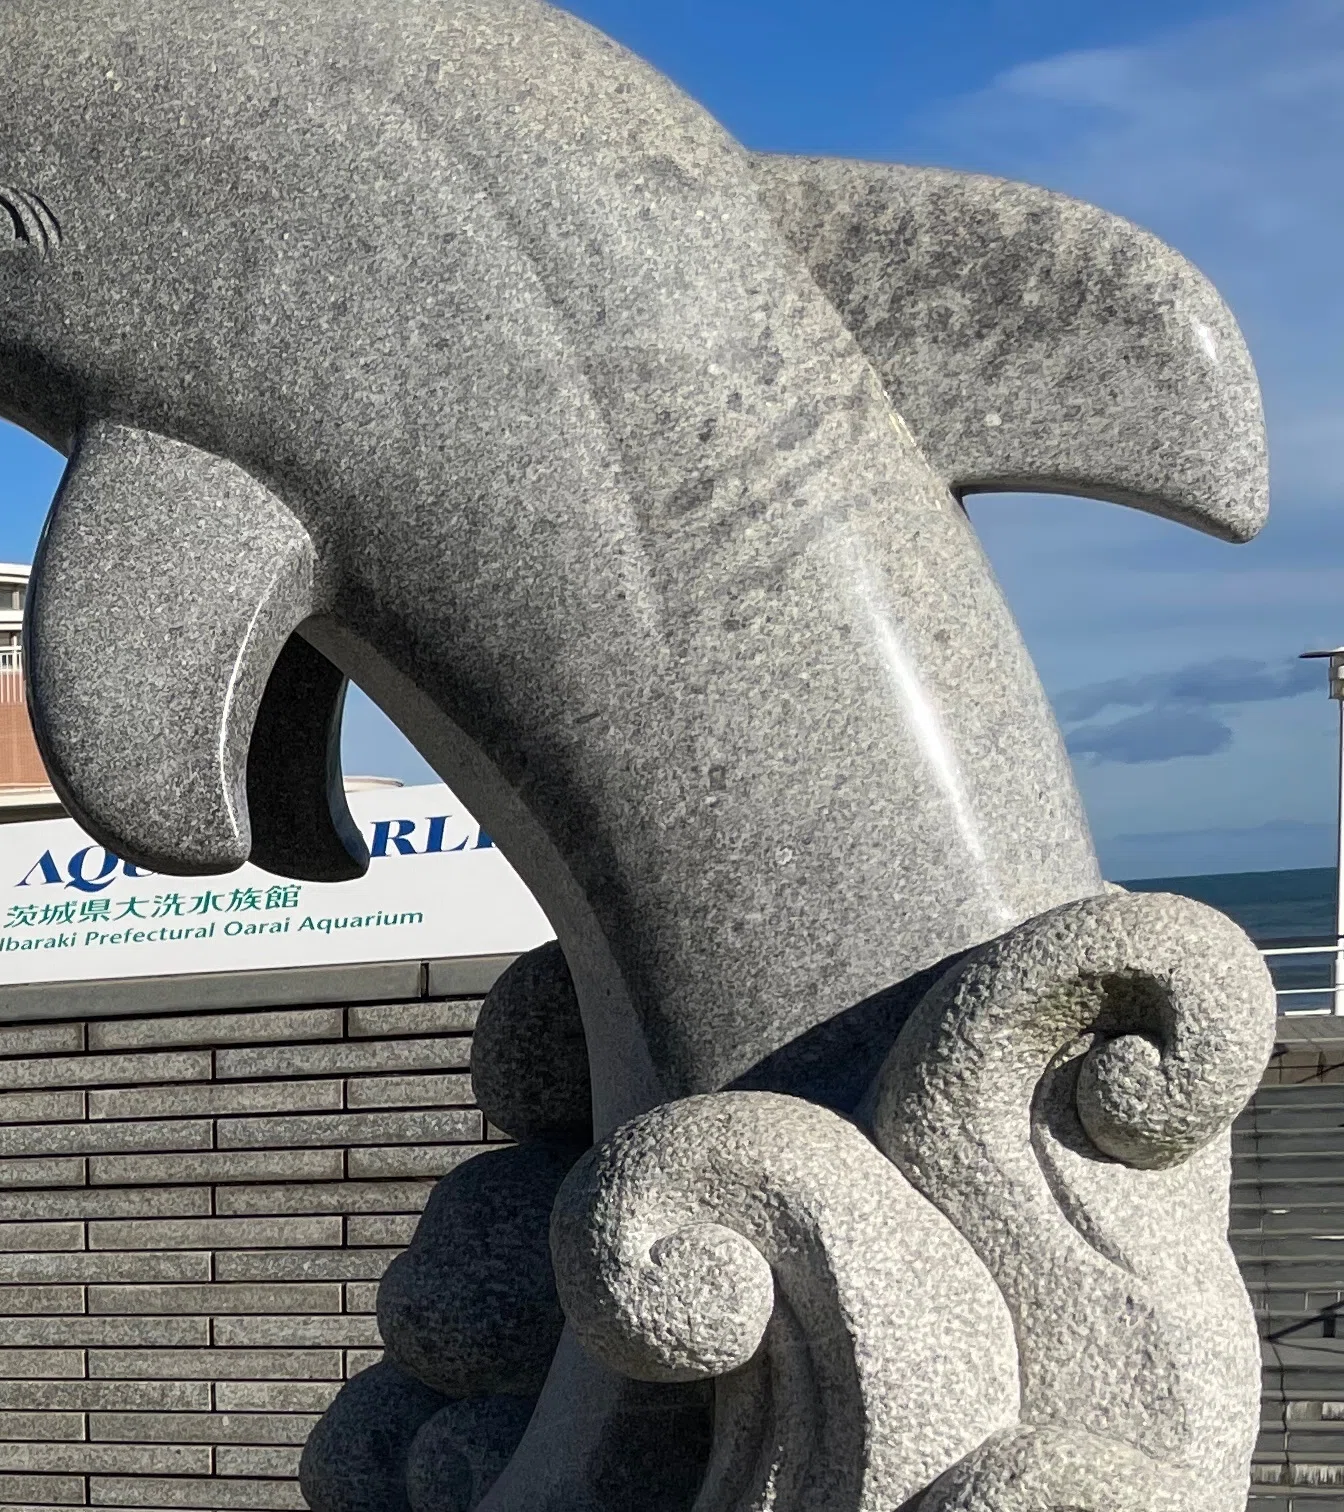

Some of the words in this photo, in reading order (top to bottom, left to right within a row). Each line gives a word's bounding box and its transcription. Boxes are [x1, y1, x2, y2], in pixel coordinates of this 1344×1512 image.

[3, 884, 302, 928] 茨城県大洗水族館
[84, 923, 215, 946] Prefectural
[223, 917, 290, 937] Oarai
[297, 910, 424, 935] Aquarium
